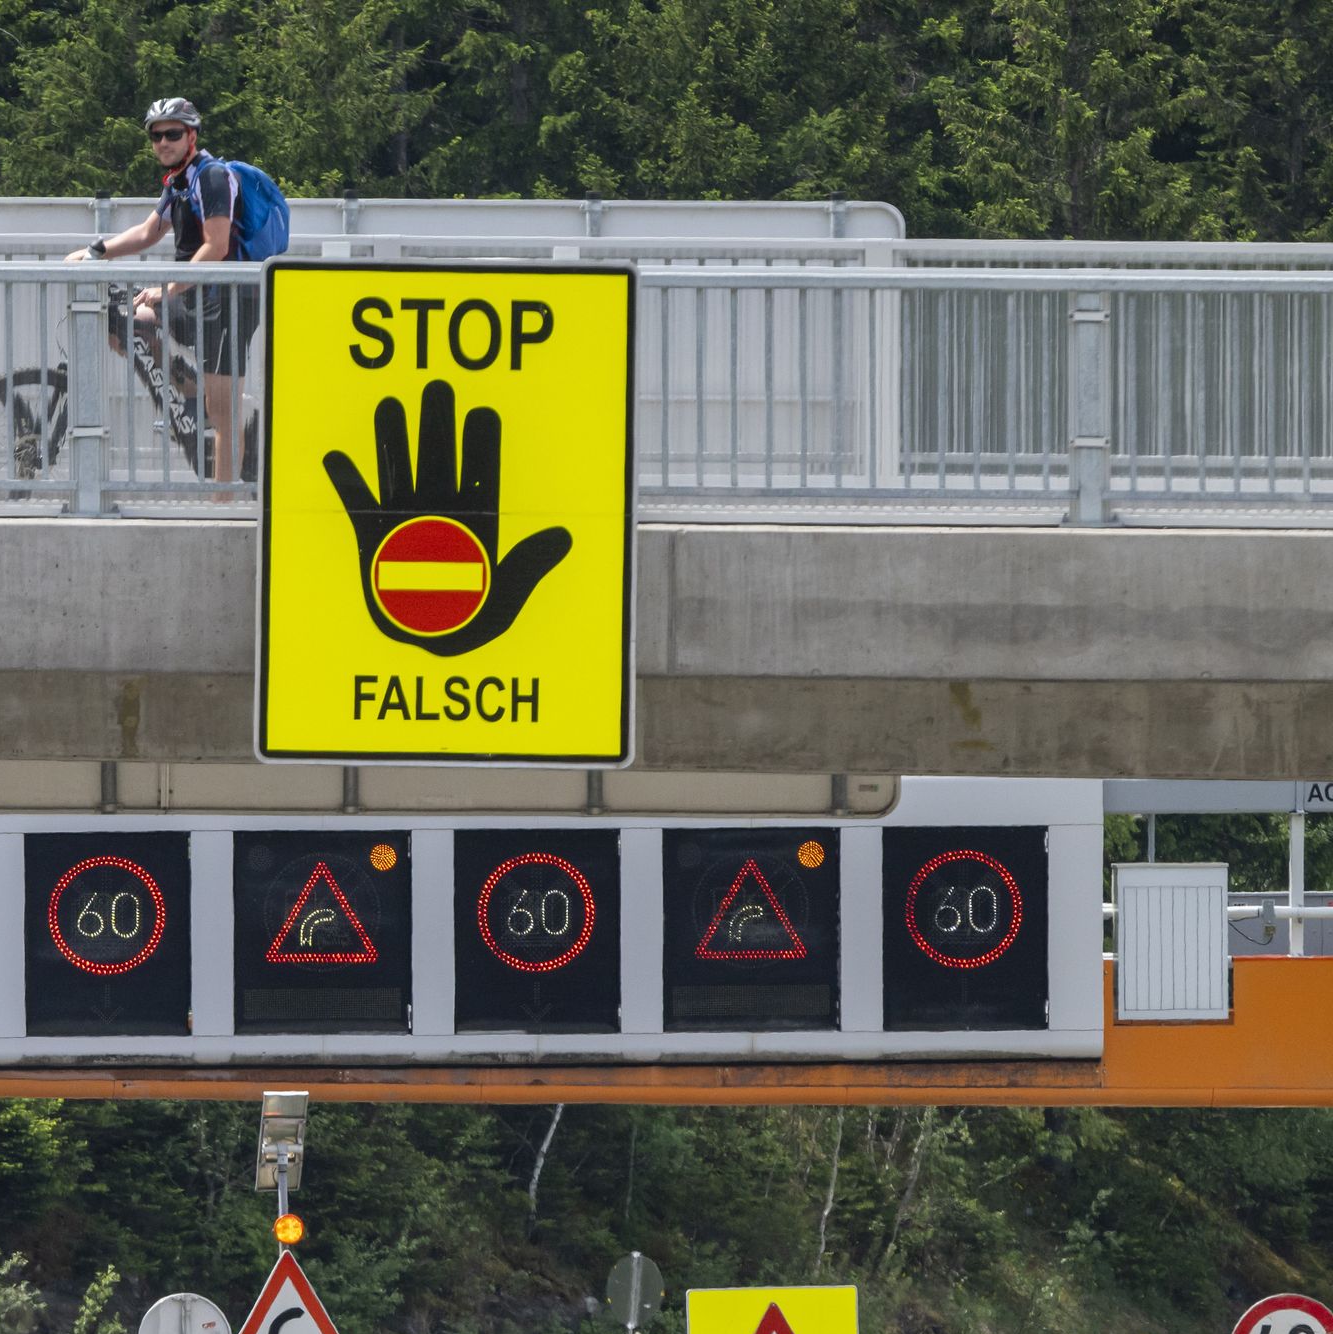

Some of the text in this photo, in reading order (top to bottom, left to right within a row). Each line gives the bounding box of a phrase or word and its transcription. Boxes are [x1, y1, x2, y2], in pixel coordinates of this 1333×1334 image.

[349, 297, 554, 371] STOP
[353, 675, 540, 723] FALSCH
[76, 892, 140, 938] 60
[507, 889, 569, 935] 60
[935, 885, 998, 933] 60
